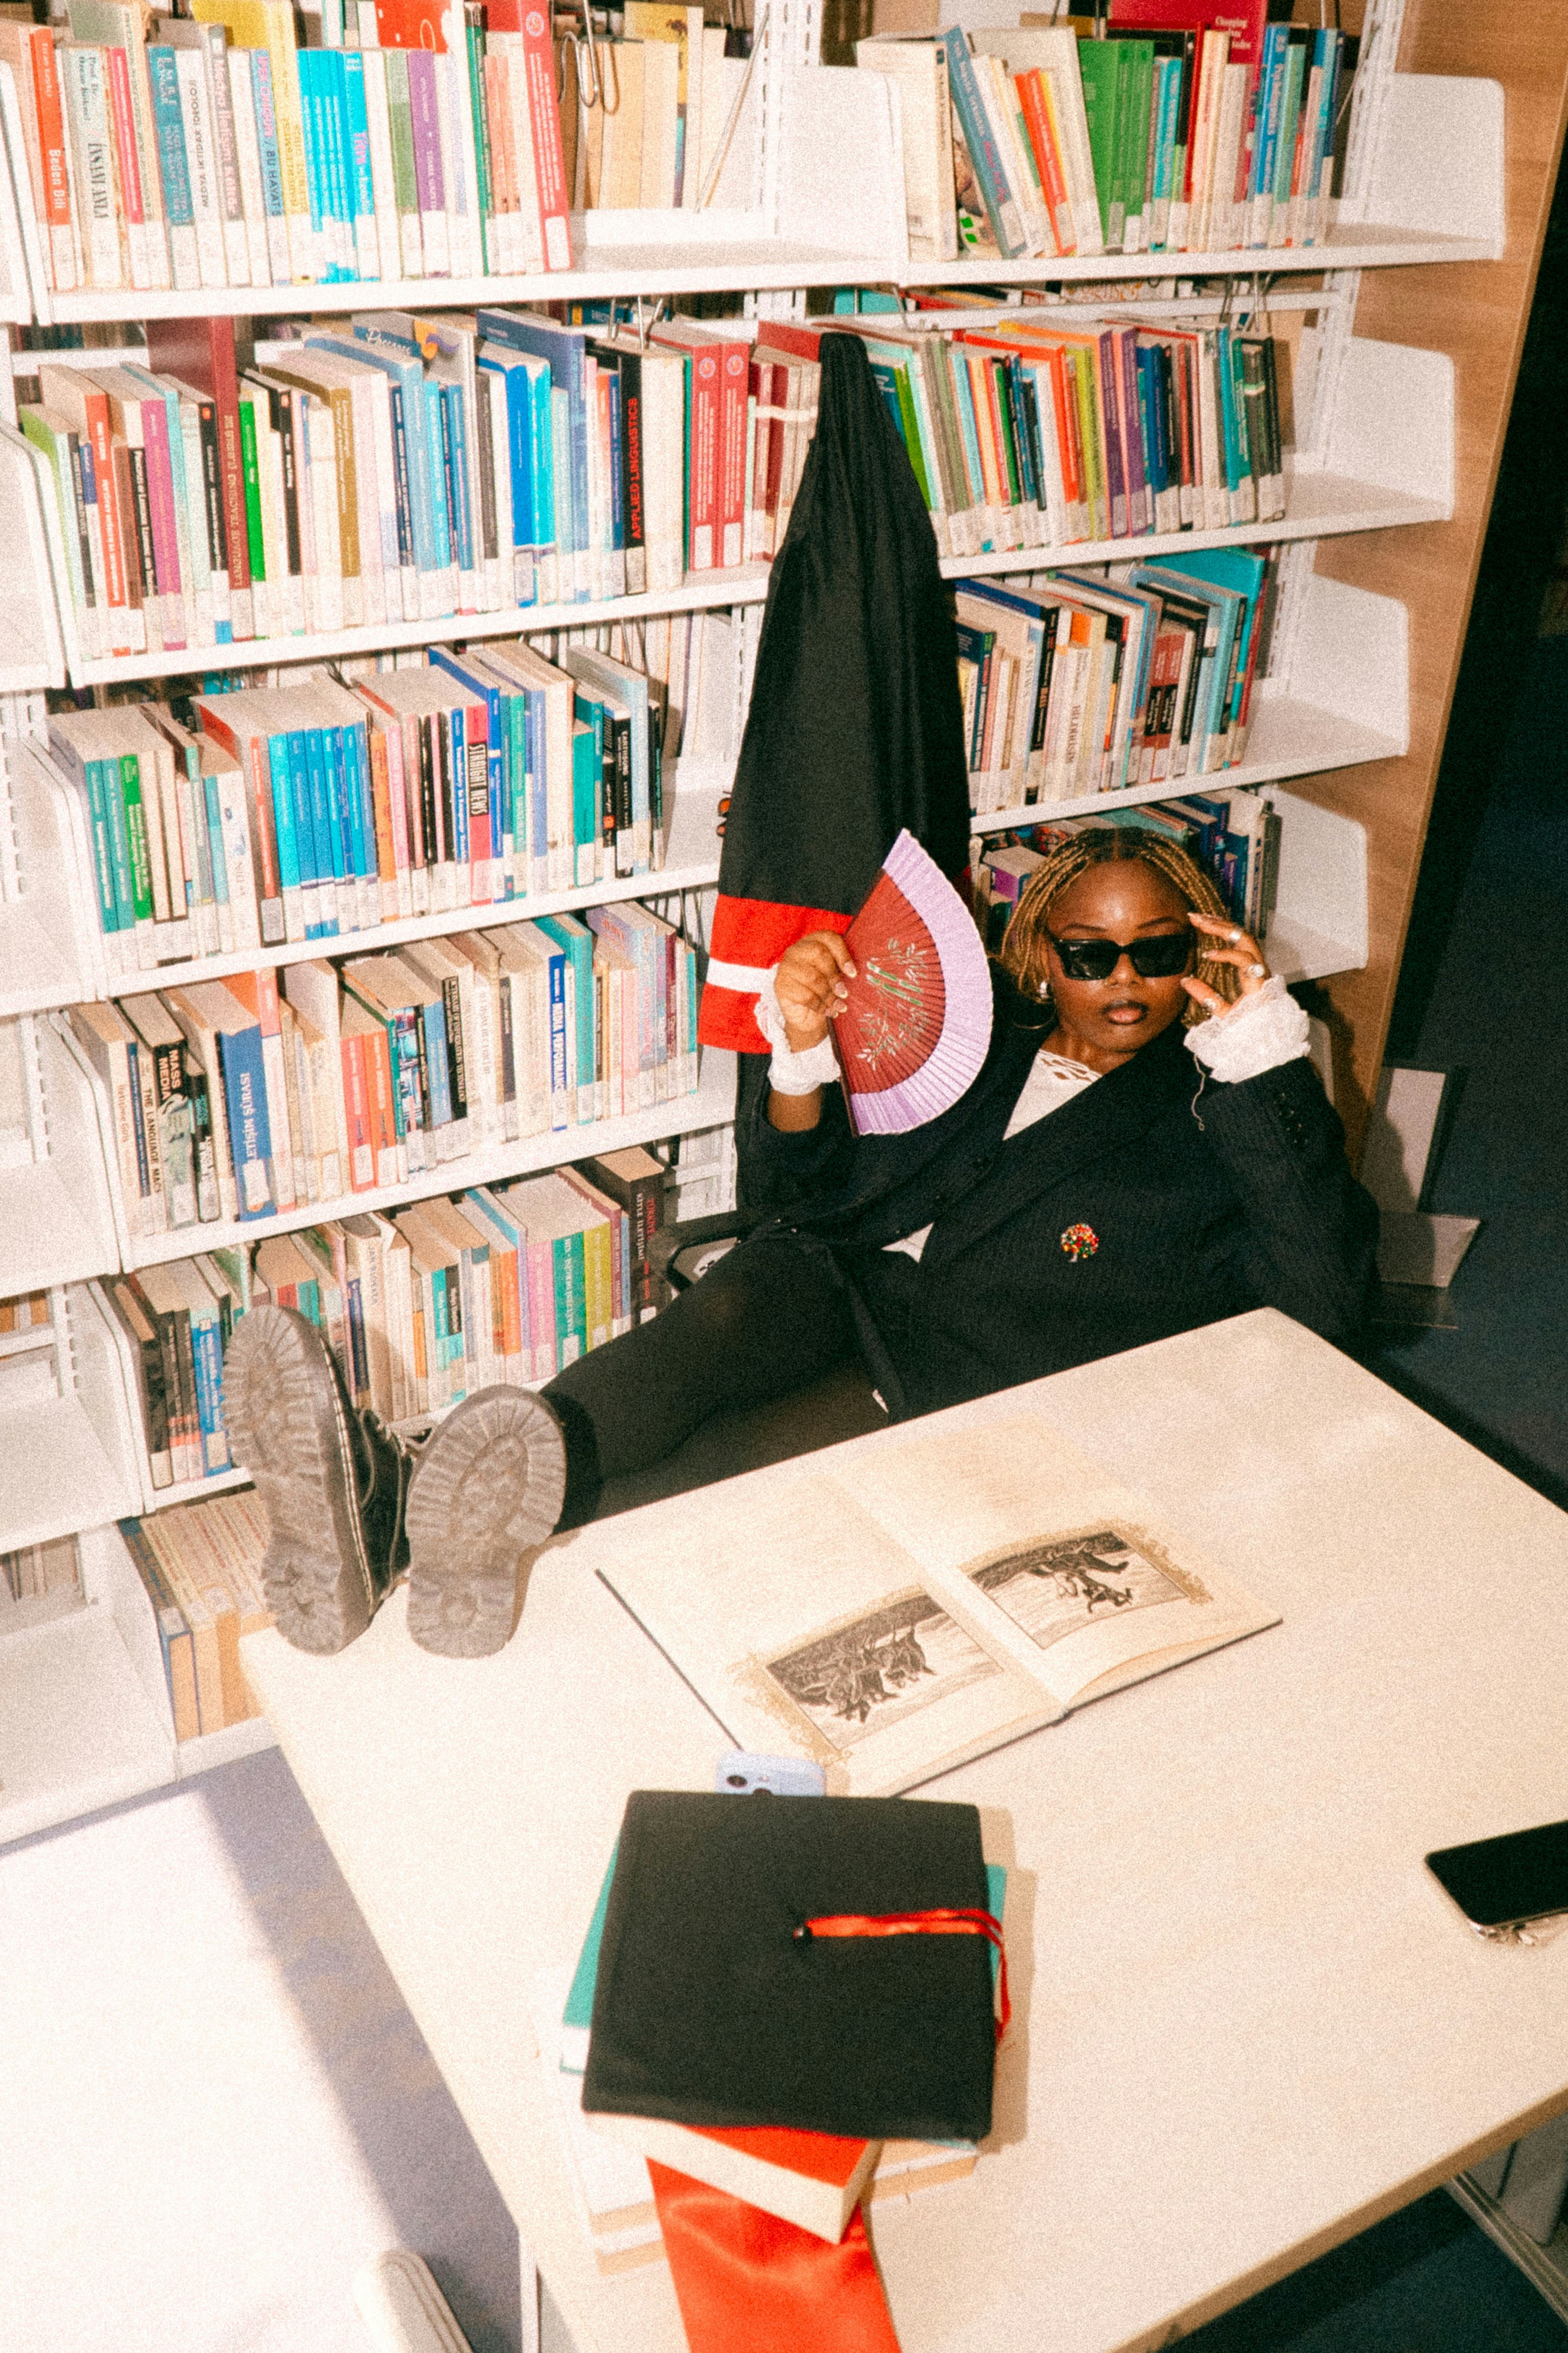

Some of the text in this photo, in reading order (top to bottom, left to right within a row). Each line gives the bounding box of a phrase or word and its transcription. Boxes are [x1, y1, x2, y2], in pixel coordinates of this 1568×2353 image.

[157, 58, 169, 105] KONGAR
[213, 60, 226, 107] Medya
[258, 57, 268, 83] İPEK
[218, 111, 232, 161] İletişim
[267, 150, 277, 166] BU
[50, 150, 66, 209] Beden Dili
[200, 174, 209, 208] MEDYA
[268, 170, 281, 208] HAYAT
[92, 190, 109, 218] ANLA
[627, 397, 641, 539] APPLIED LINGUISTICS
[226, 473, 239, 526] TEACHING
[231, 529, 243, 586] LANGUAGE
[468, 744, 488, 815] STRAIGHT NEWS
[169, 1049, 182, 1088] MASS
[552, 1002, 565, 1091] MEDIA PERFORMANC
[143, 1088, 153, 1108] THE
[159, 1057, 172, 1100] MEDIA
[146, 1111, 159, 1164] LANGUAGE
[241, 1118, 261, 1164] LETİŞİM
[635, 1193, 645, 1260] KİTLE İLETİŞİMİ
